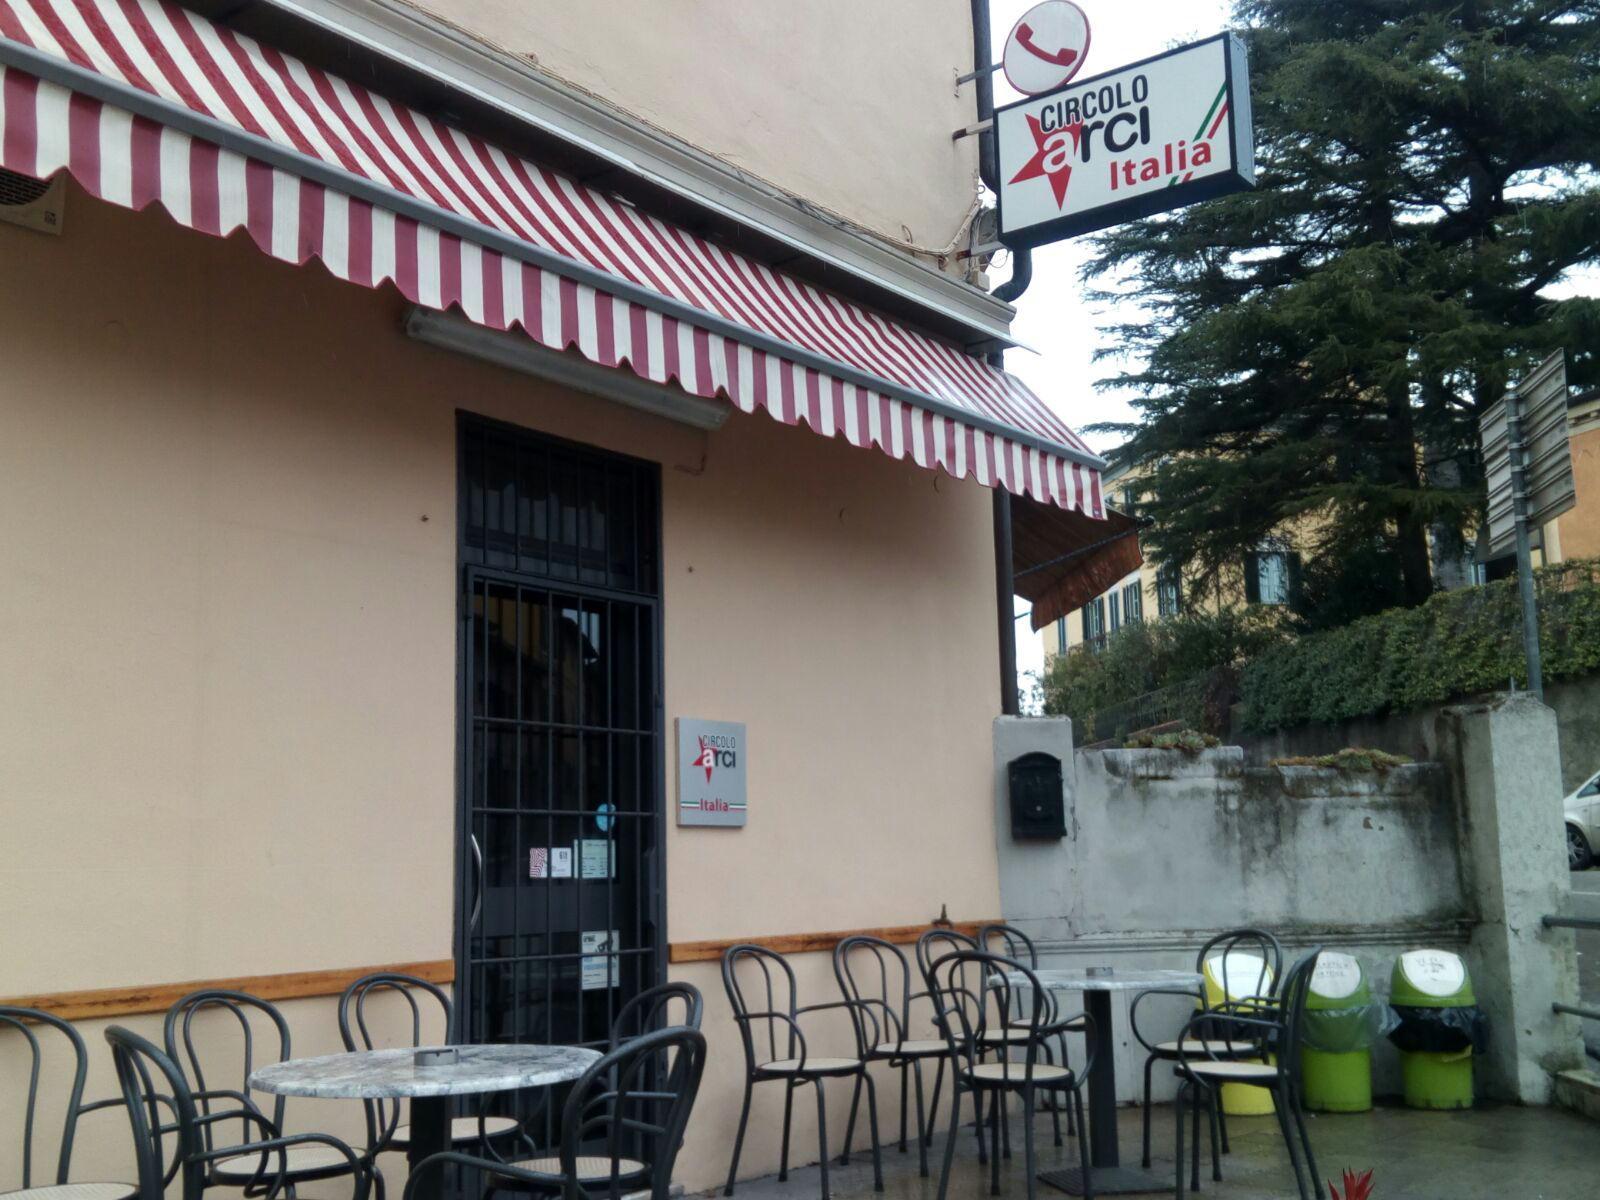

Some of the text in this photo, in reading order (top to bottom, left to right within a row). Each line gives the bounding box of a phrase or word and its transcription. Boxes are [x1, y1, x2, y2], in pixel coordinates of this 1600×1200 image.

[1040, 74, 1148, 133] CIRCOLO
[1042, 105, 1150, 174] arci
[1110, 140, 1212, 190] Italia
[702, 748, 736, 768] arci
[703, 734, 736, 749] CIRCOLO
[700, 798, 729, 811] Italia
